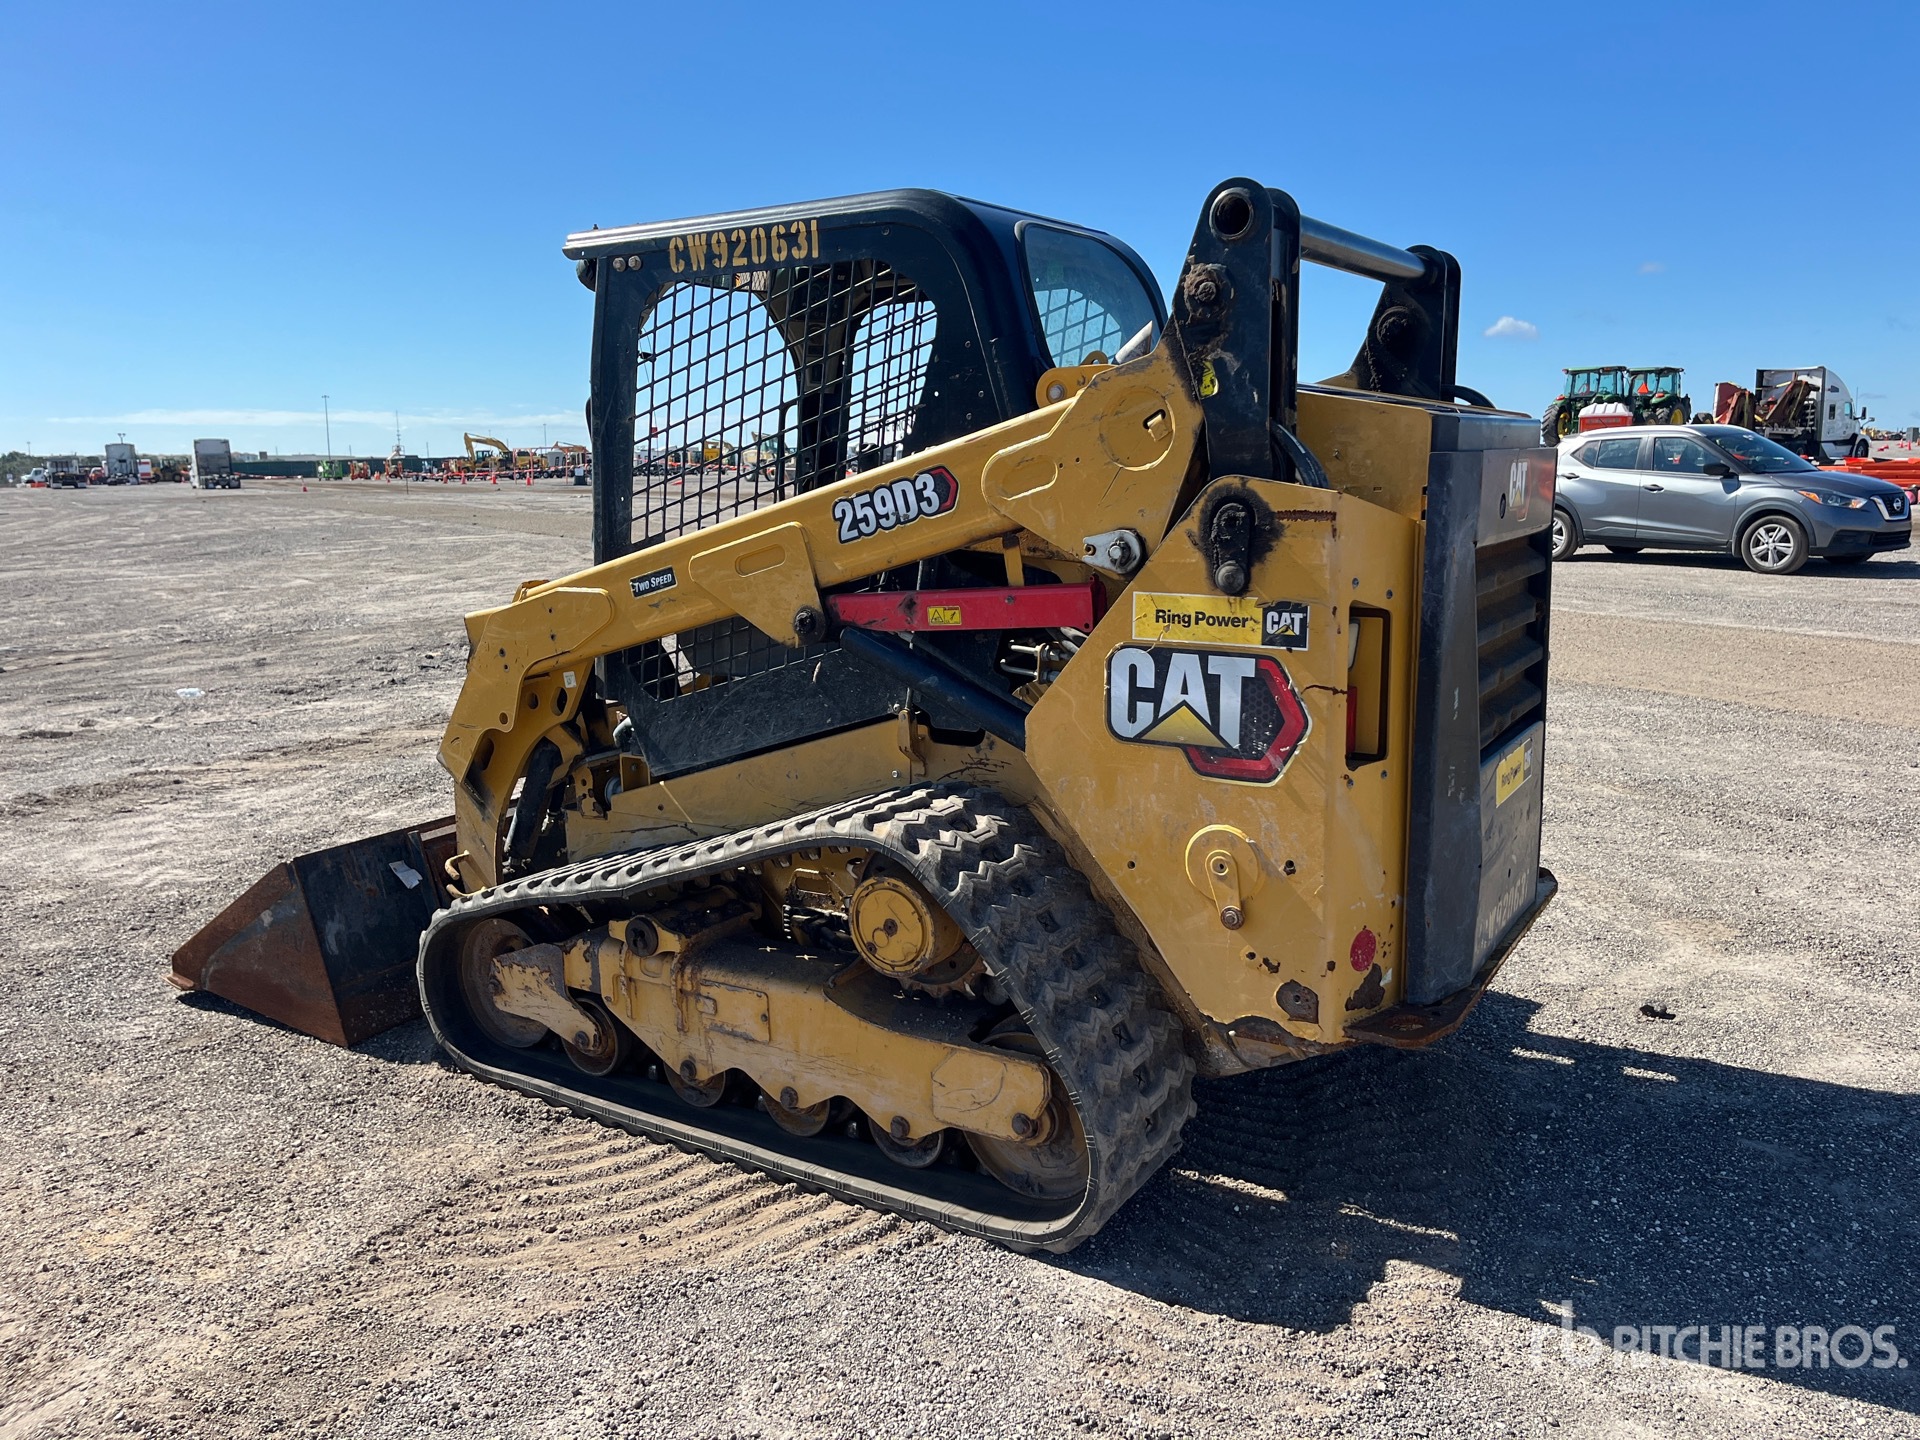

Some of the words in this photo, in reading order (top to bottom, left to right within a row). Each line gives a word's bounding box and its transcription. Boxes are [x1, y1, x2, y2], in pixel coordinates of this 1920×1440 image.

[669, 219, 819, 273] CW920631
[834, 473, 940, 541] 259D3
[1509, 462, 1527, 507] CAT
[1155, 609, 1191, 628] Ring
[1194, 613, 1248, 628] Power
[1266, 611, 1304, 635] CAT
[1110, 648, 1256, 750] CAT
